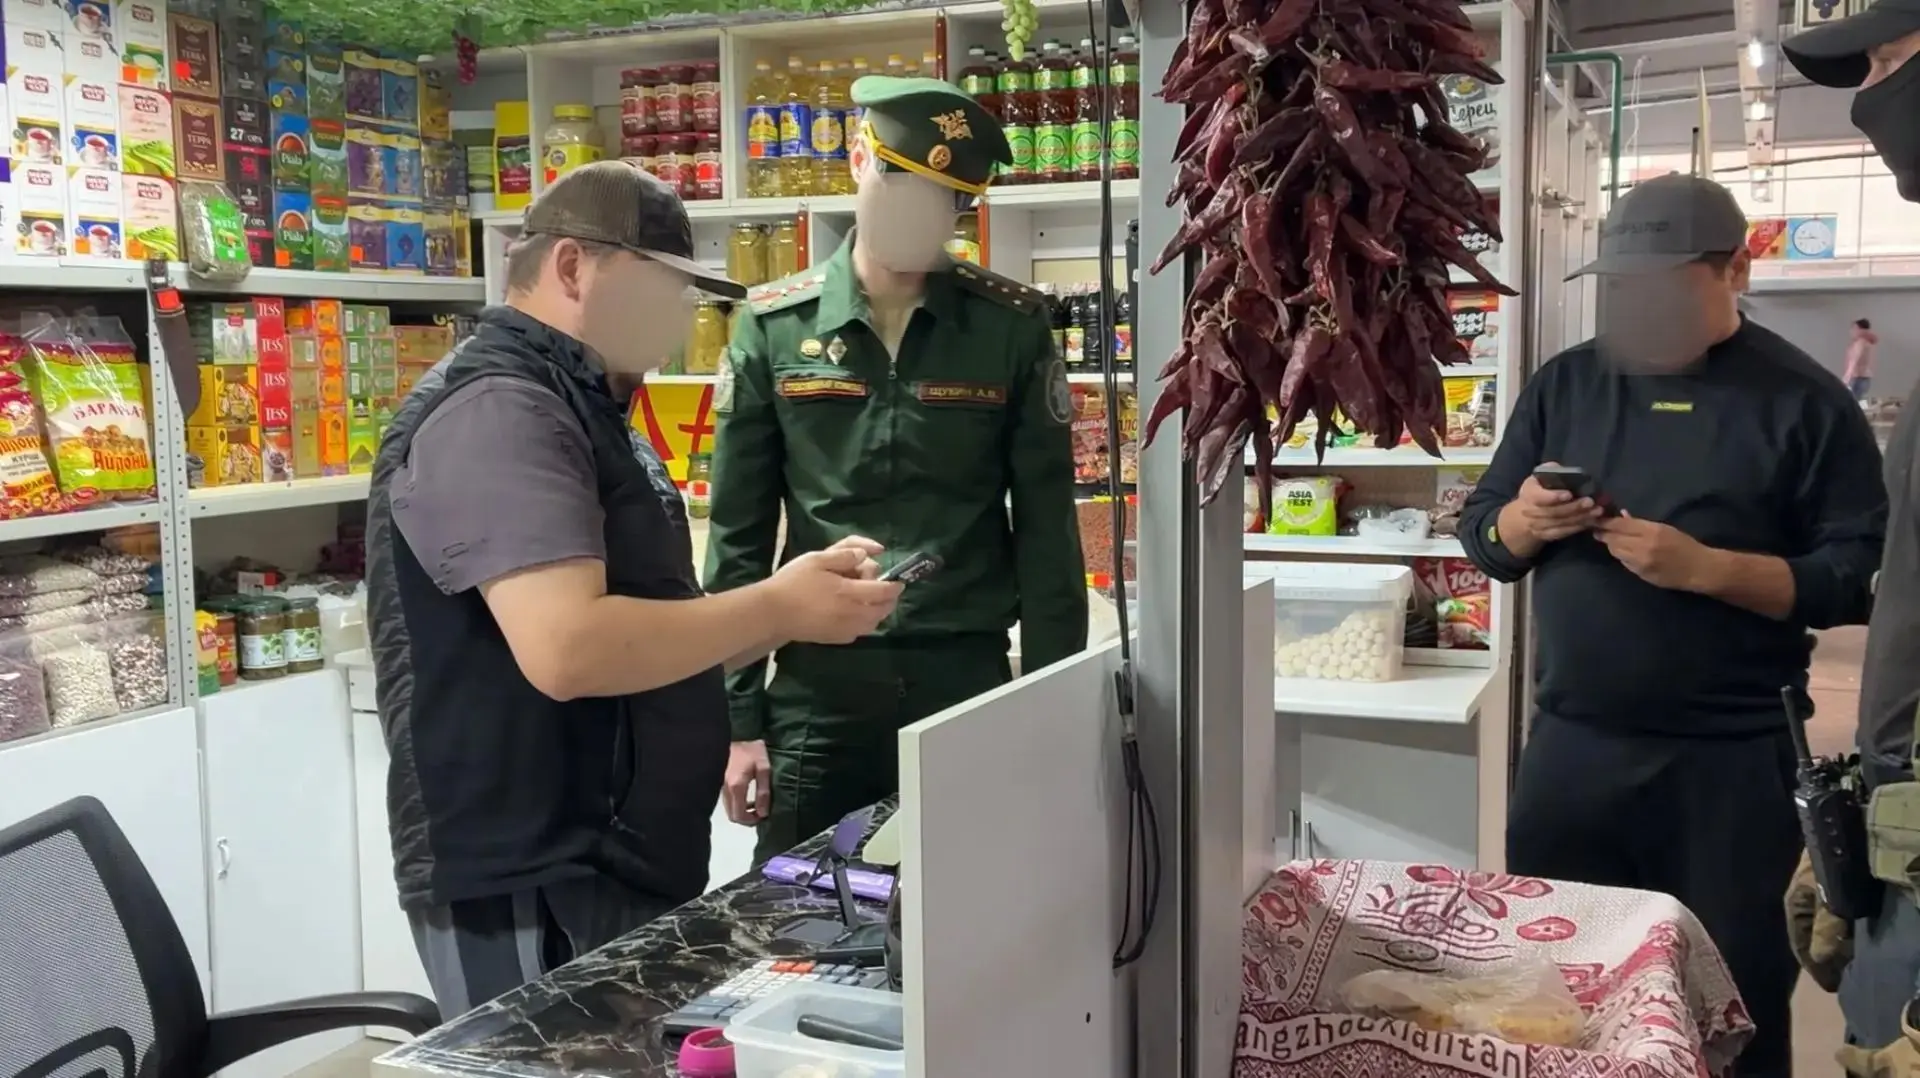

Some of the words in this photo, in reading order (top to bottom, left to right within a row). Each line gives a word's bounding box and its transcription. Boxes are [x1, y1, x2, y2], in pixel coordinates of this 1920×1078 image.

[229, 128, 244, 141] 27
[257, 302, 281, 317] TESS
[261, 337, 284, 353] TESS
[264, 372, 287, 387] TESS
[265, 406, 288, 422] TESS
[1287, 490, 1313, 499] ASIA
[1287, 499, 1313, 507] FEST
[1449, 569, 1488, 591] 100
